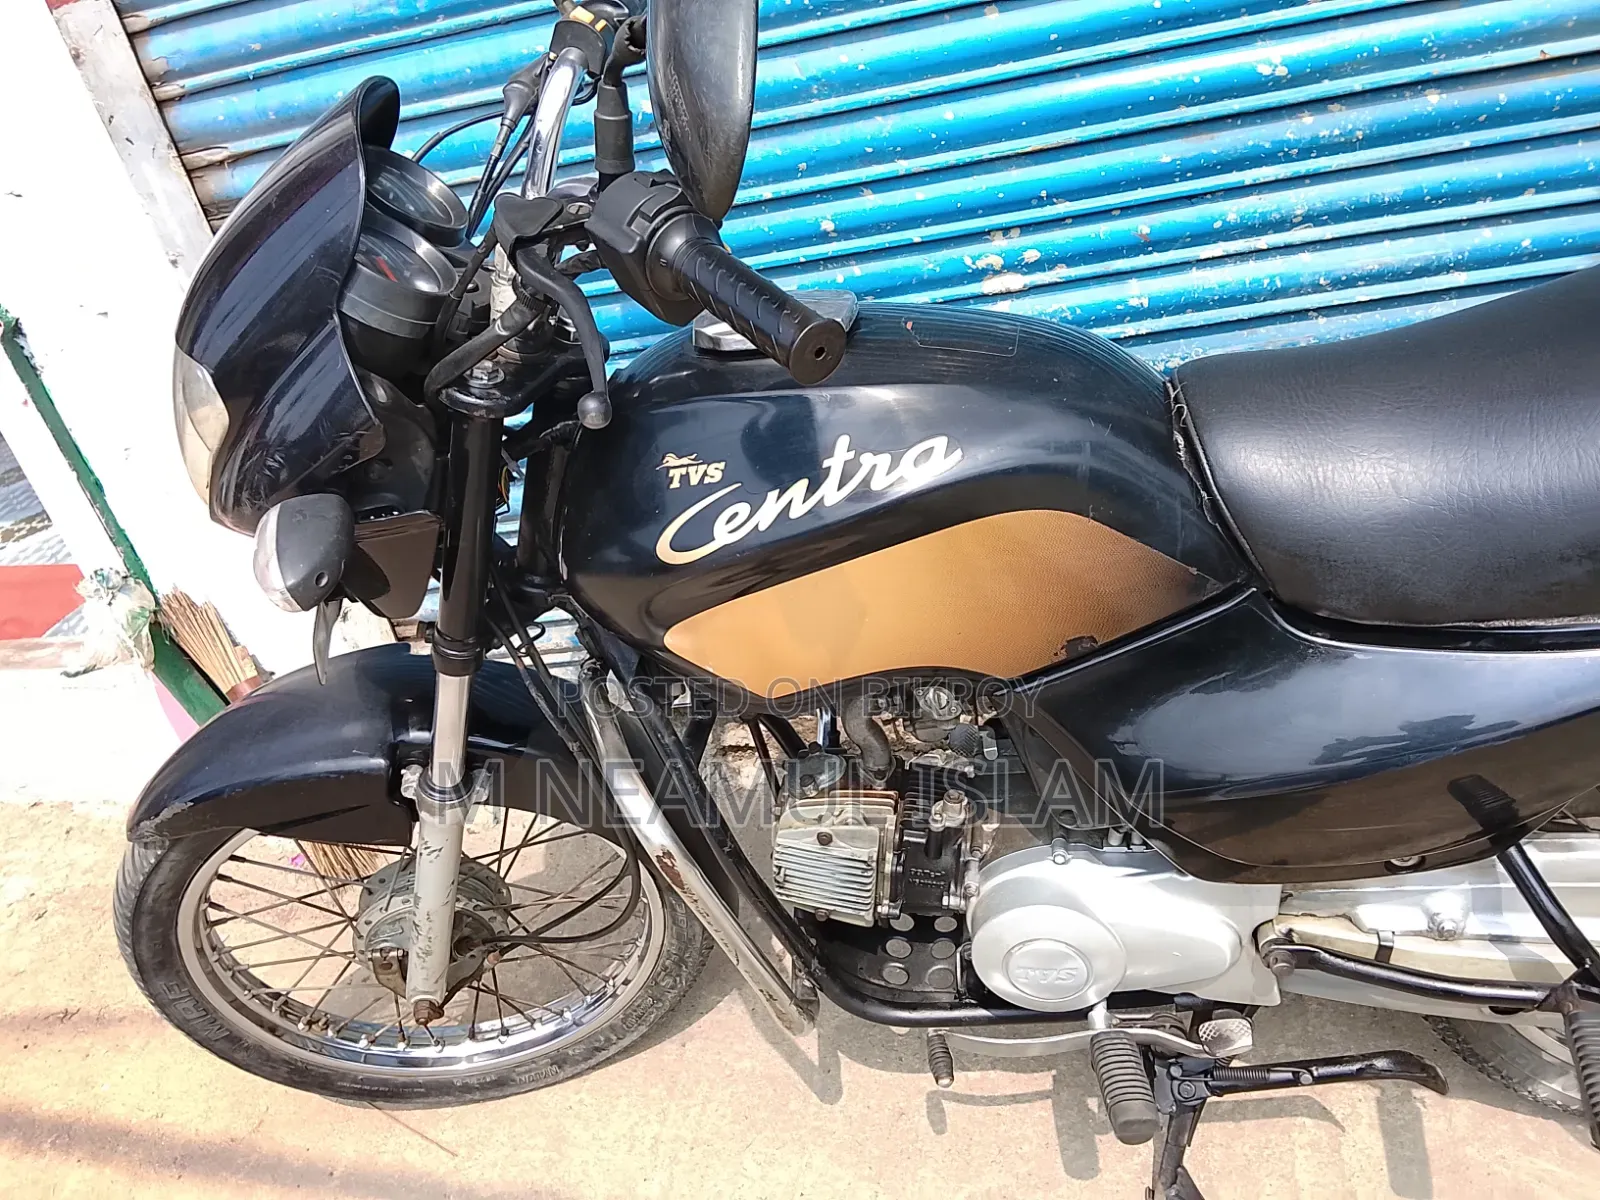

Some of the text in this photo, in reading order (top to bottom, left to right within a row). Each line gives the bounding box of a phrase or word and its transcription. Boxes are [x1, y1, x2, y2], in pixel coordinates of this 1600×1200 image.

[668, 460, 726, 489] TVS
[655, 433, 964, 566] Centra
[1015, 966, 1078, 984] TVS
[159, 981, 231, 1042] MRF
